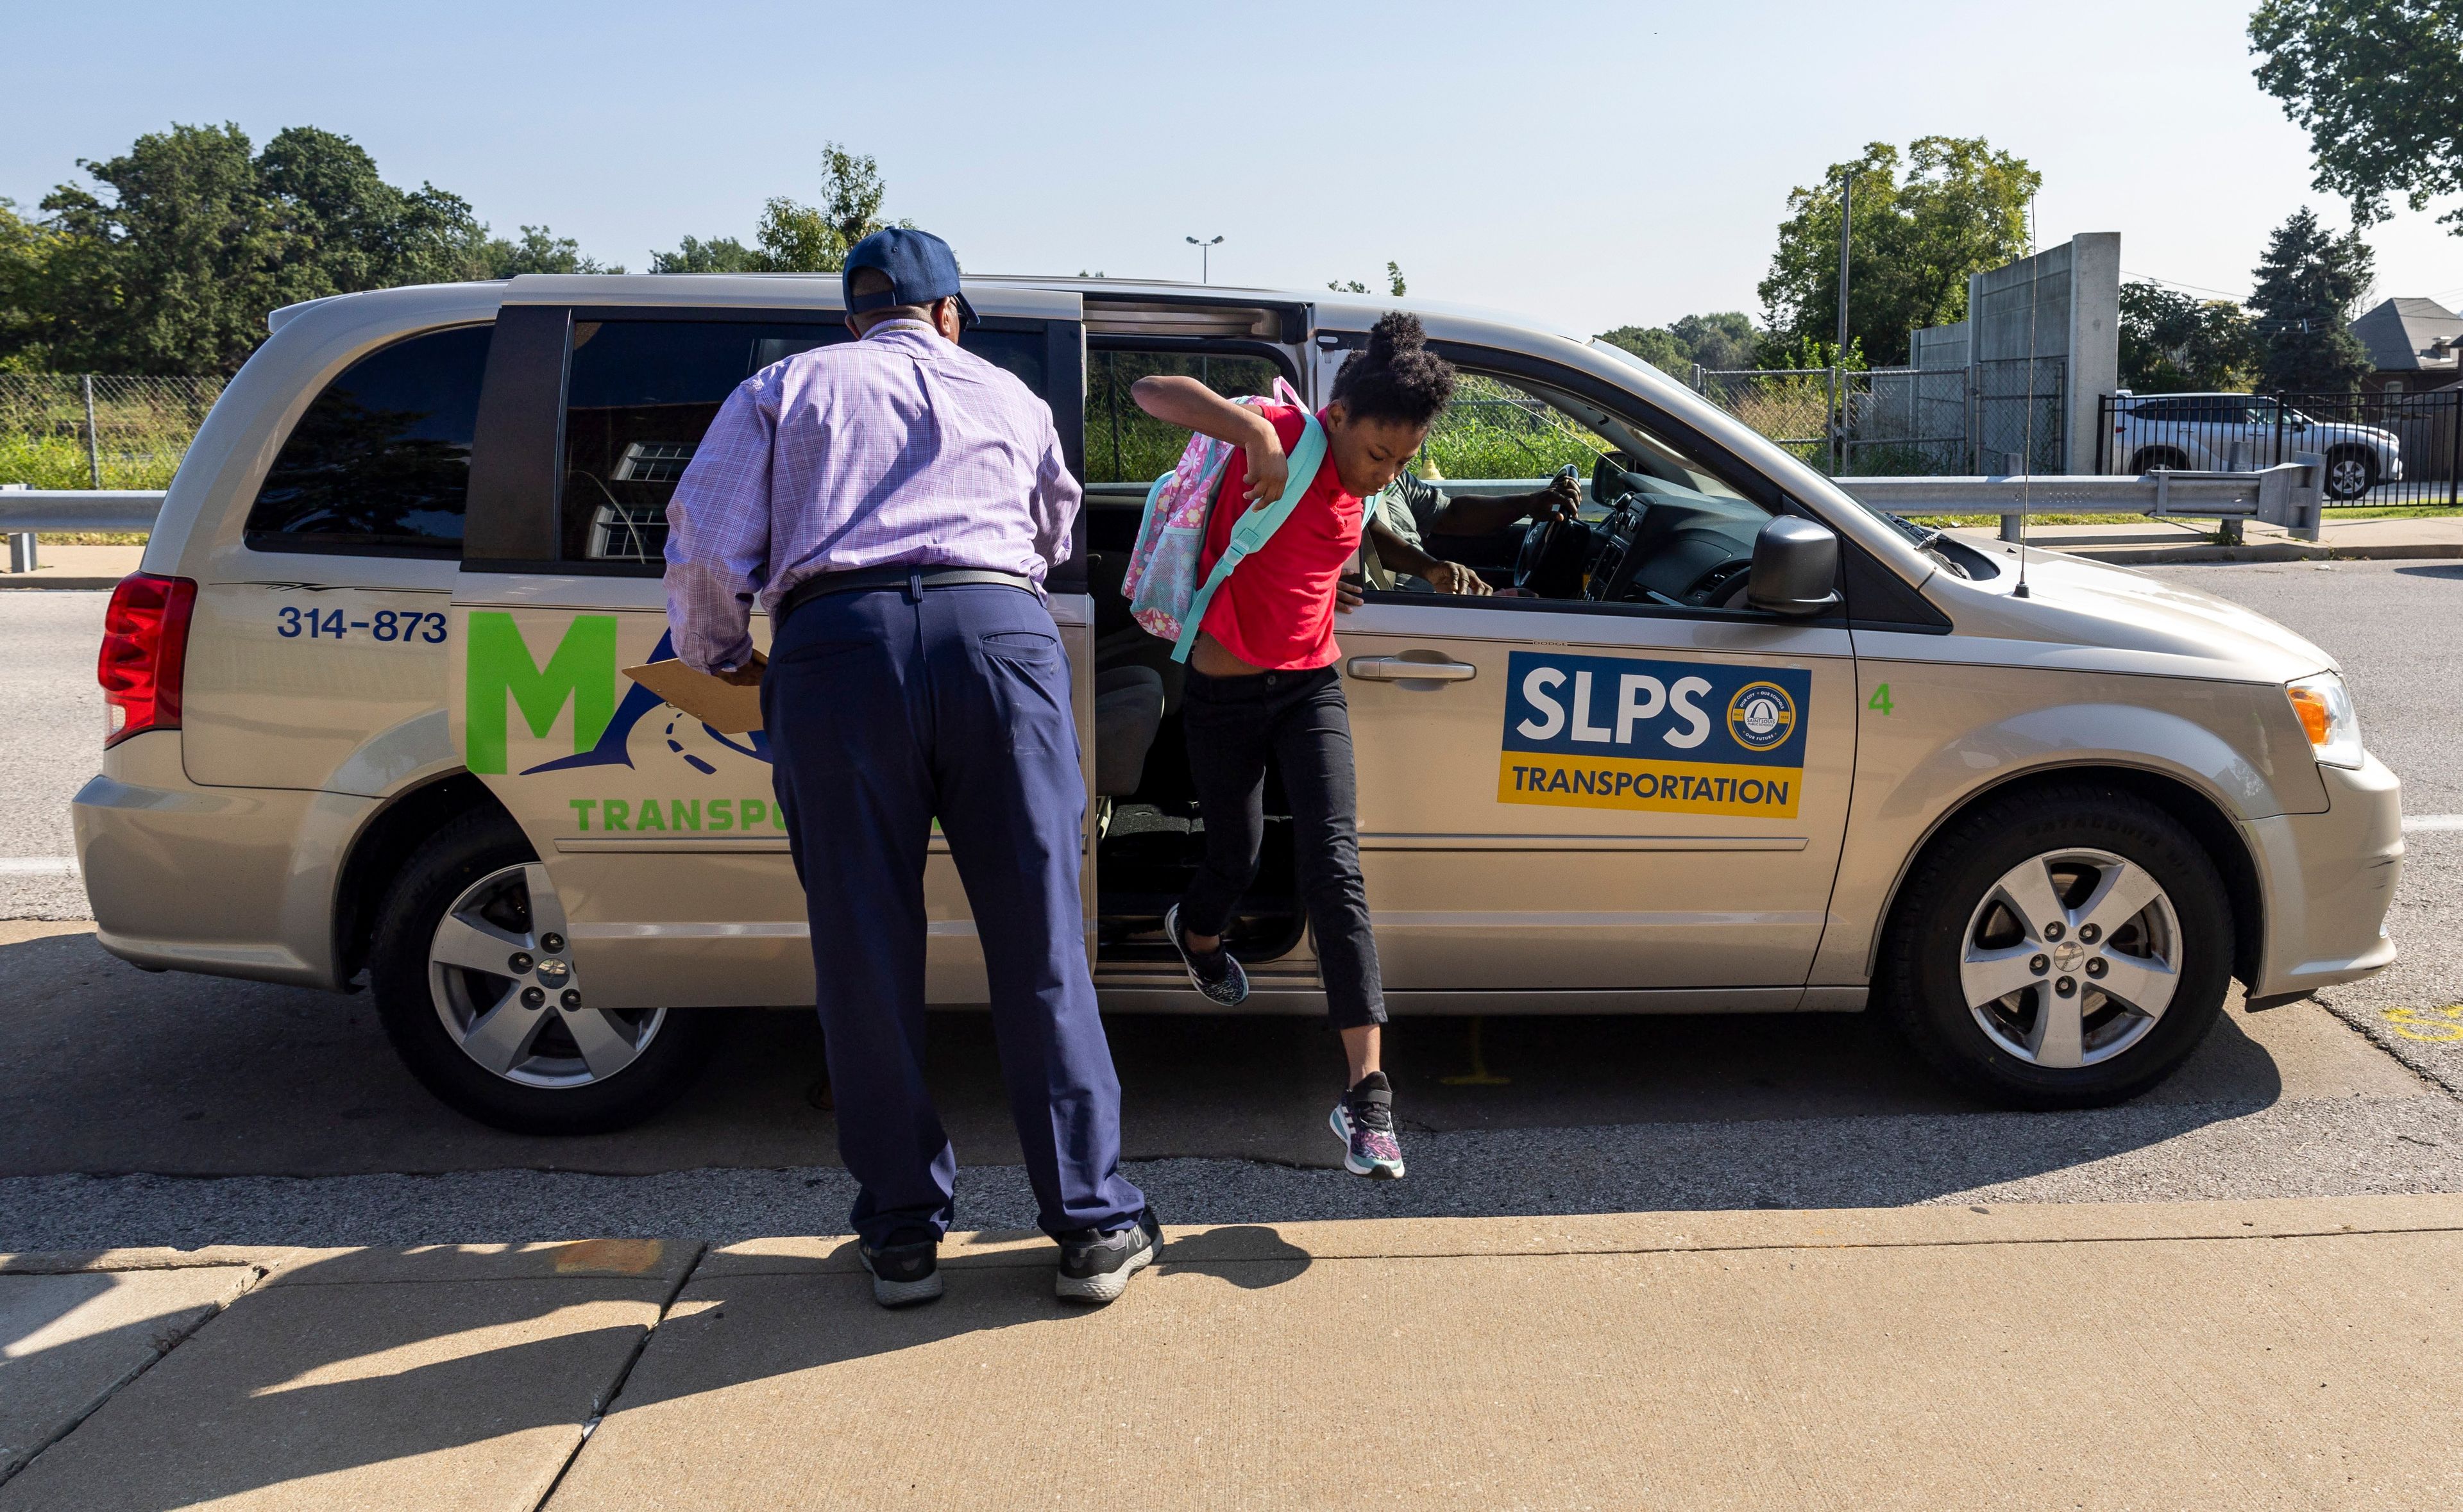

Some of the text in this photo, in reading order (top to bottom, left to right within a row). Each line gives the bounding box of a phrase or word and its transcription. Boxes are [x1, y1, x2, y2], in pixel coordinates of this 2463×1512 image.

[277, 607, 448, 644] 314-873
[1516, 667, 1713, 749] SLPS
[1739, 699, 1748, 707] OUR
[1770, 693, 1784, 710] SCHOOLS
[1868, 683, 1895, 716] 4
[1745, 732, 1756, 741] OUR
[1512, 766, 1789, 805] TRANSPORTATION
